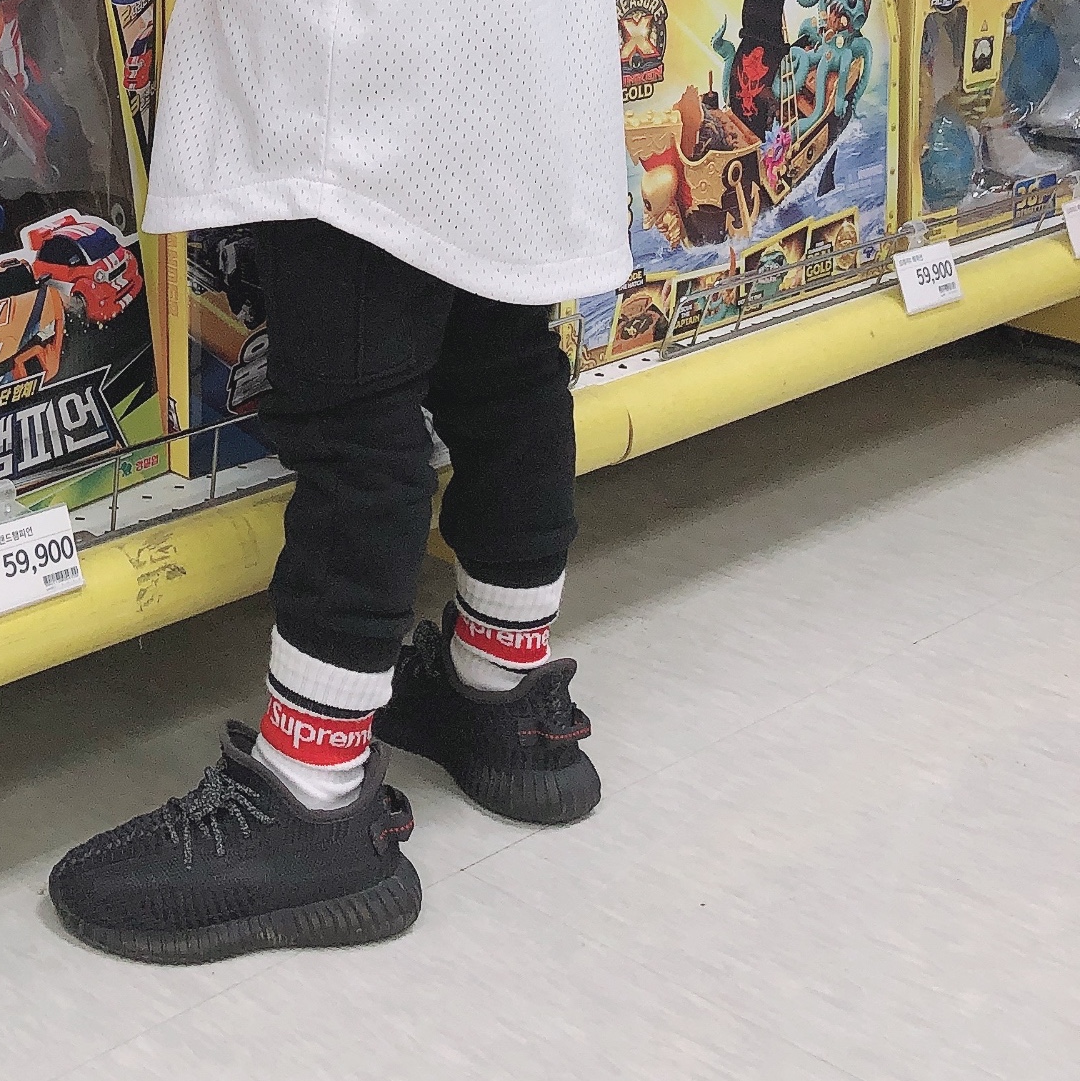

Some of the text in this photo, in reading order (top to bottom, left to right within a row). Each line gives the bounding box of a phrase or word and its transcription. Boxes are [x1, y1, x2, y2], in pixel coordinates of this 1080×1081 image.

[806, 260, 833, 279] GOLD
[916, 260, 954, 286] 59,900
[2, 535, 75, 581] 59,900
